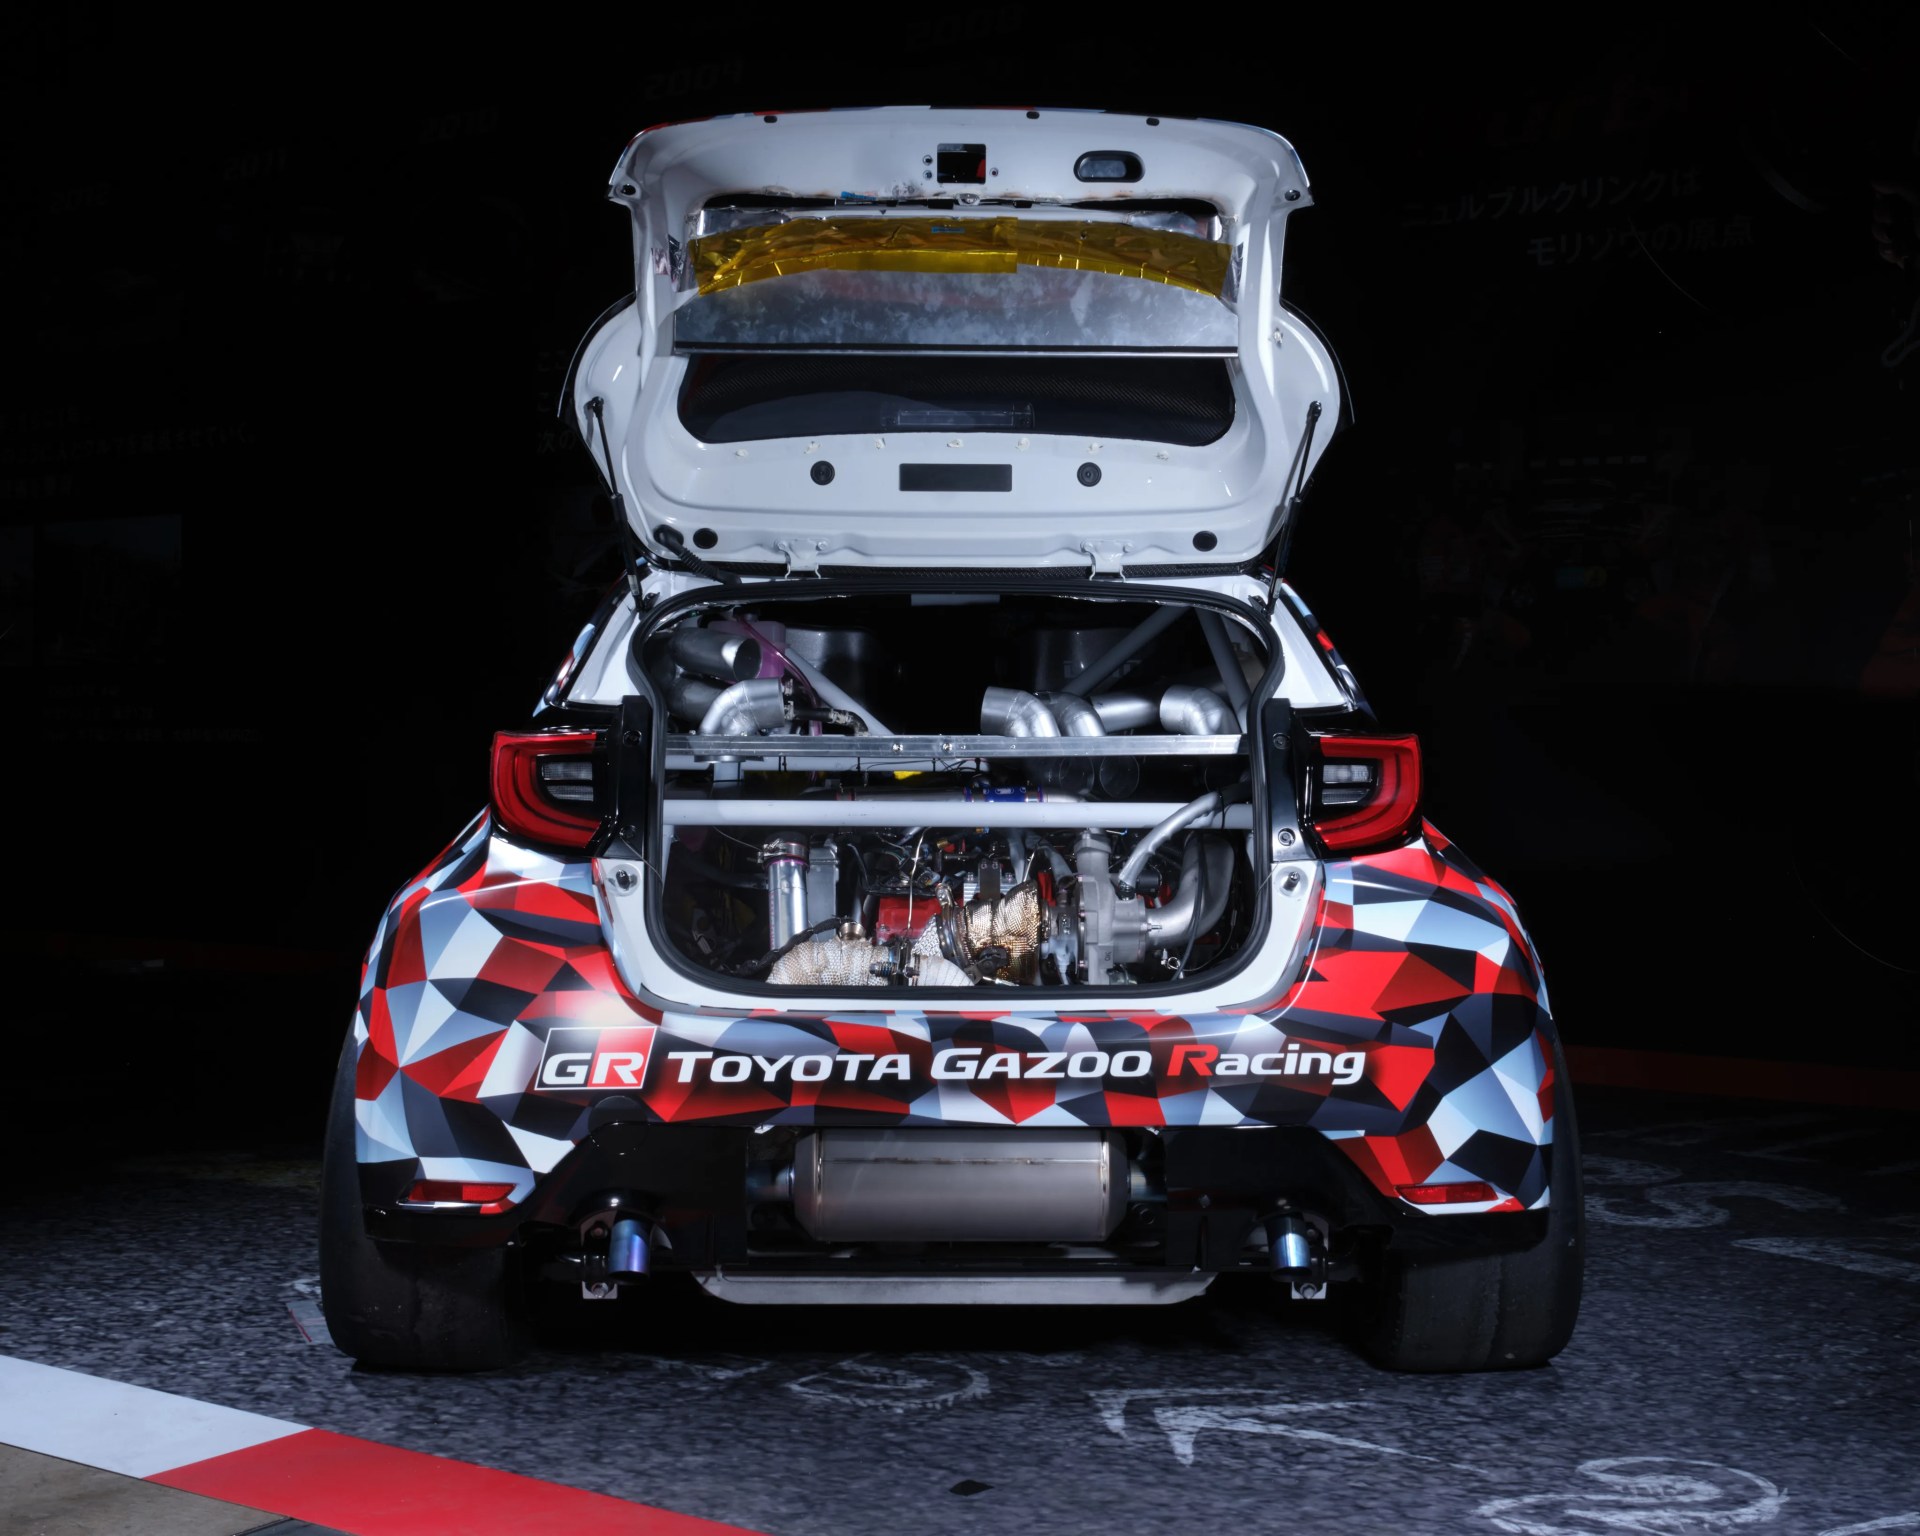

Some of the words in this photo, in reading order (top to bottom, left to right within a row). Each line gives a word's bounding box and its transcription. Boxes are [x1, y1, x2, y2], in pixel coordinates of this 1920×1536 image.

[541, 1051, 646, 1085] GR
[667, 1050, 912, 1084] TOYOTA
[929, 1047, 1153, 1081] GAZOO
[1166, 1043, 1367, 1086] Racing
